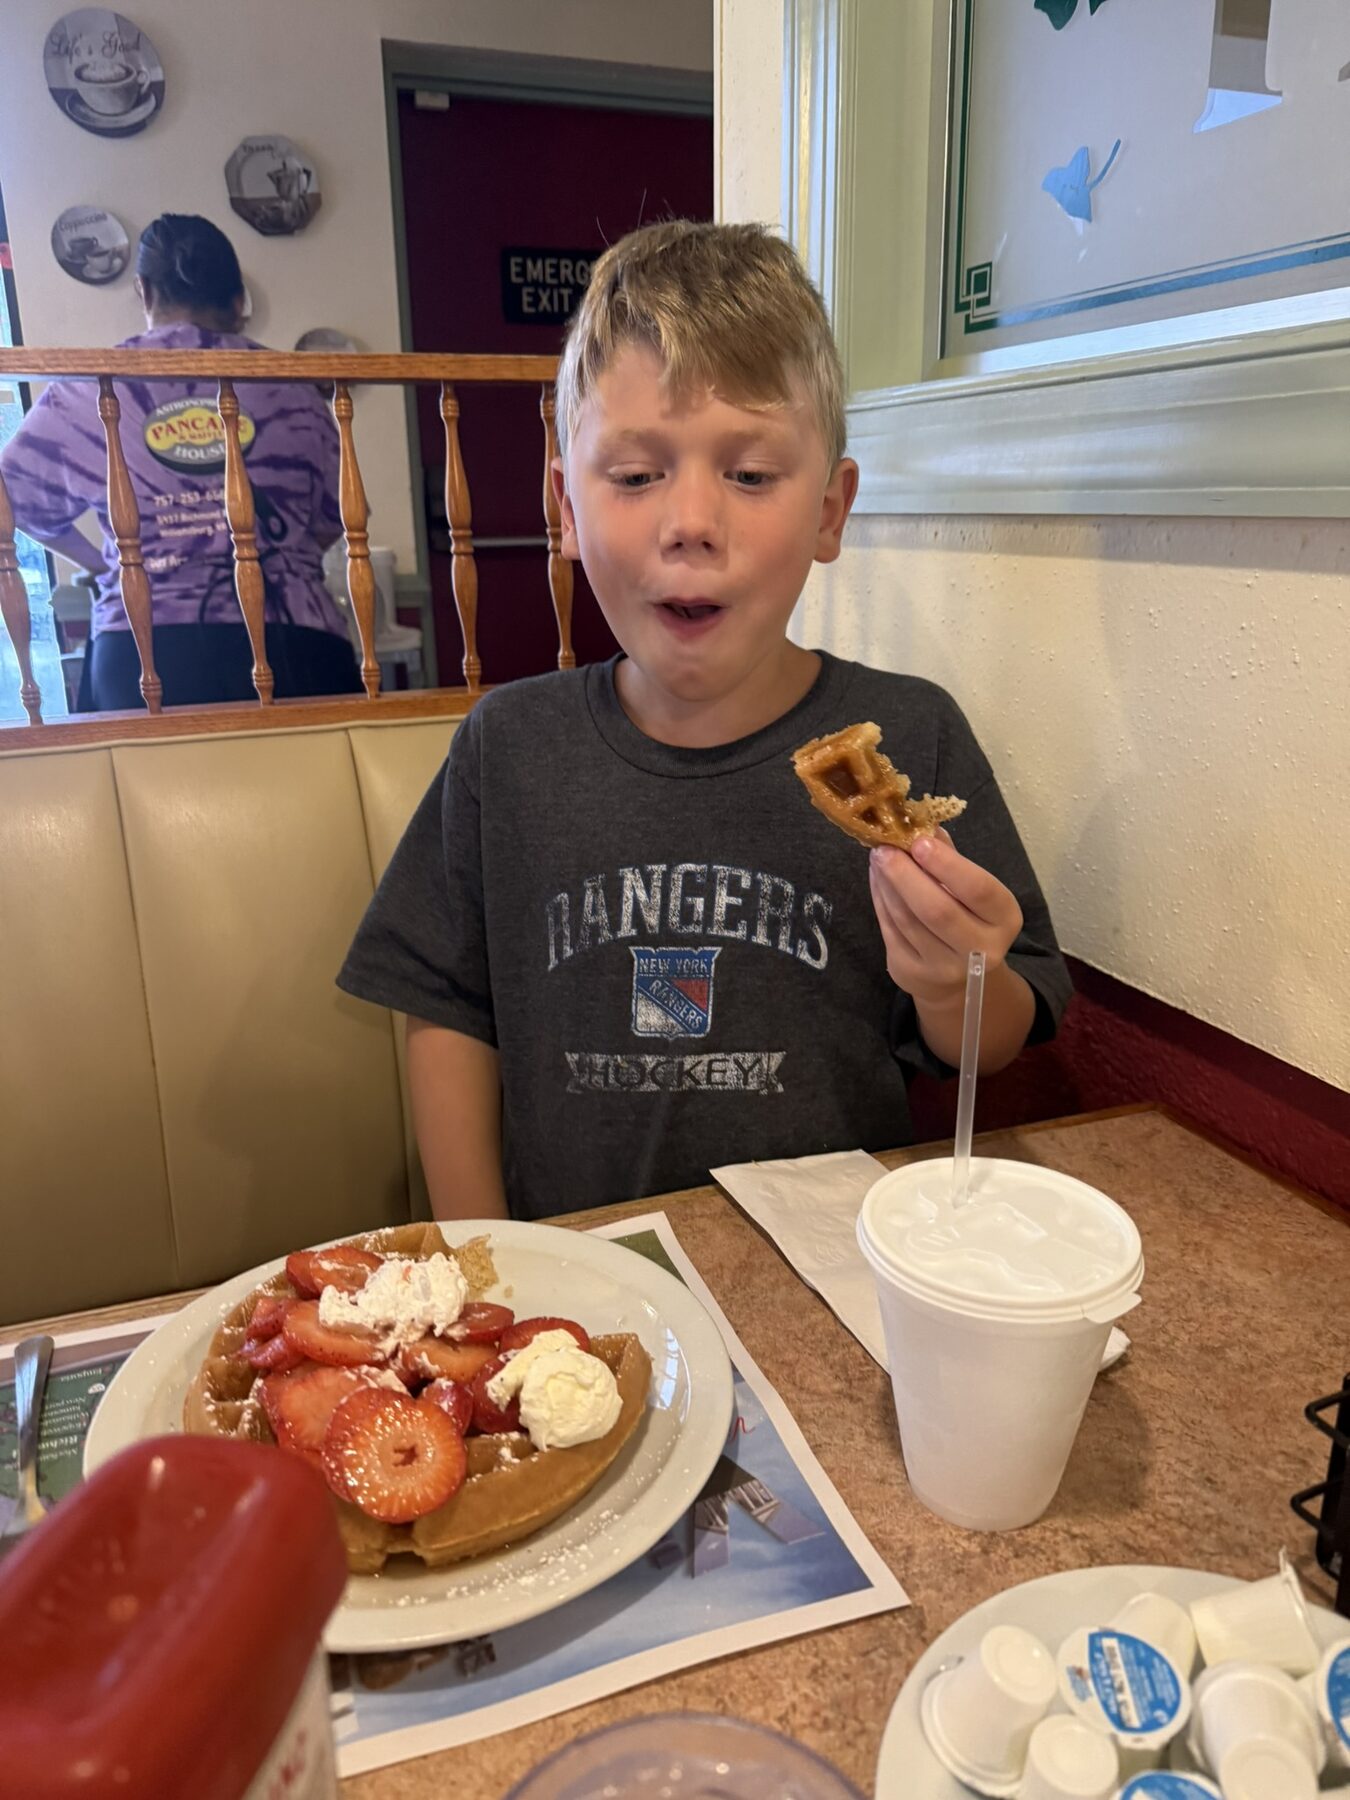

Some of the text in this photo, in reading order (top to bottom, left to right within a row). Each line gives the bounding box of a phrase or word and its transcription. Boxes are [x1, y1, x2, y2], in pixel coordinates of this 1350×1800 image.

[49, 31, 141, 64] Life's Good
[510, 256, 592, 286] EMERG
[521, 286, 573, 313] EXIT
[151, 415, 248, 441] PANCAE
[547, 862, 834, 971] RANGERS
[639, 957, 709, 974] NEW YORK
[648, 979, 704, 1030] RANGERS
[585, 1057, 763, 1090] HOCKEY
